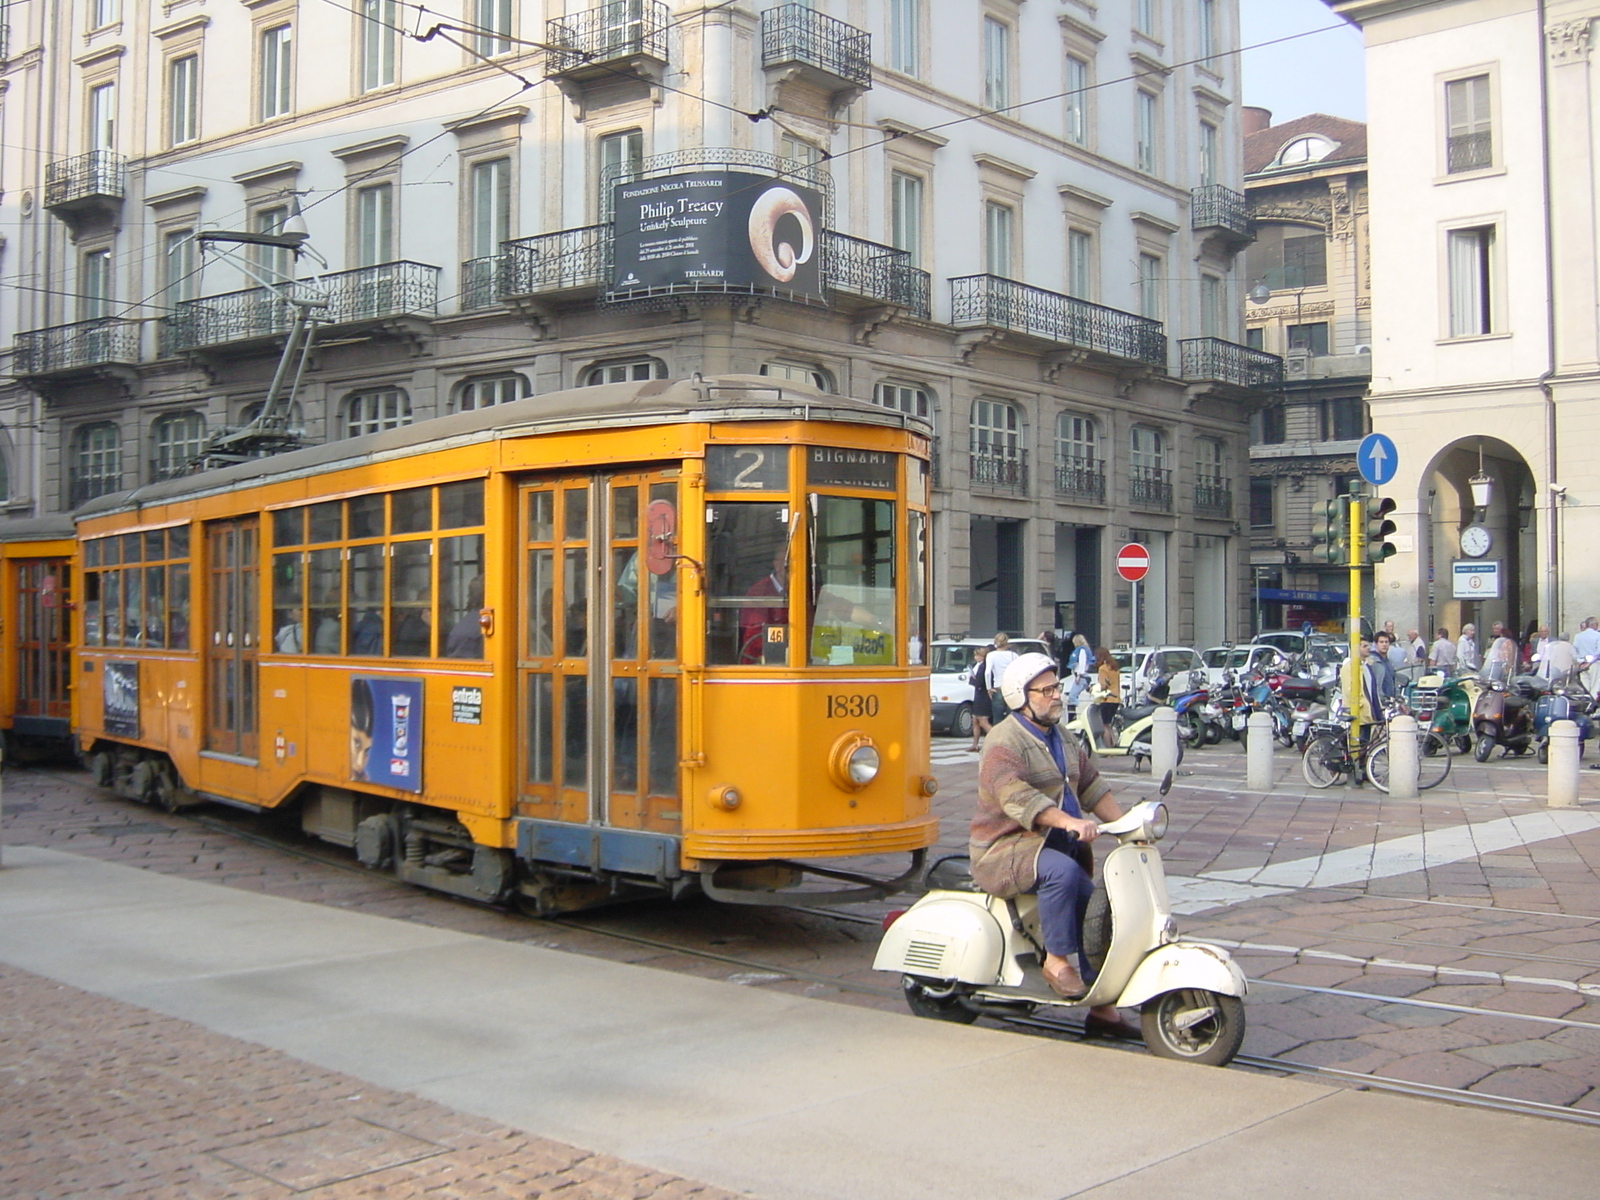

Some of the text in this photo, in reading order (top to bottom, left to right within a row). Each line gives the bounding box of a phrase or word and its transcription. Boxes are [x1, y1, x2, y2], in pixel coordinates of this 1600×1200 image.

[622, 180, 723, 199] FONDAZIONE NICOLA TRUSSARDI
[640, 198, 724, 220] Philip Treacy
[670, 217, 708, 228] Sculpture
[685, 270, 724, 278] TRUSSARDI
[814, 449, 887, 464] BIGNAMI
[733, 448, 765, 488] 2
[769, 629, 783, 643] 46
[452, 688, 481, 704] entrata
[826, 694, 879, 718] 1830
